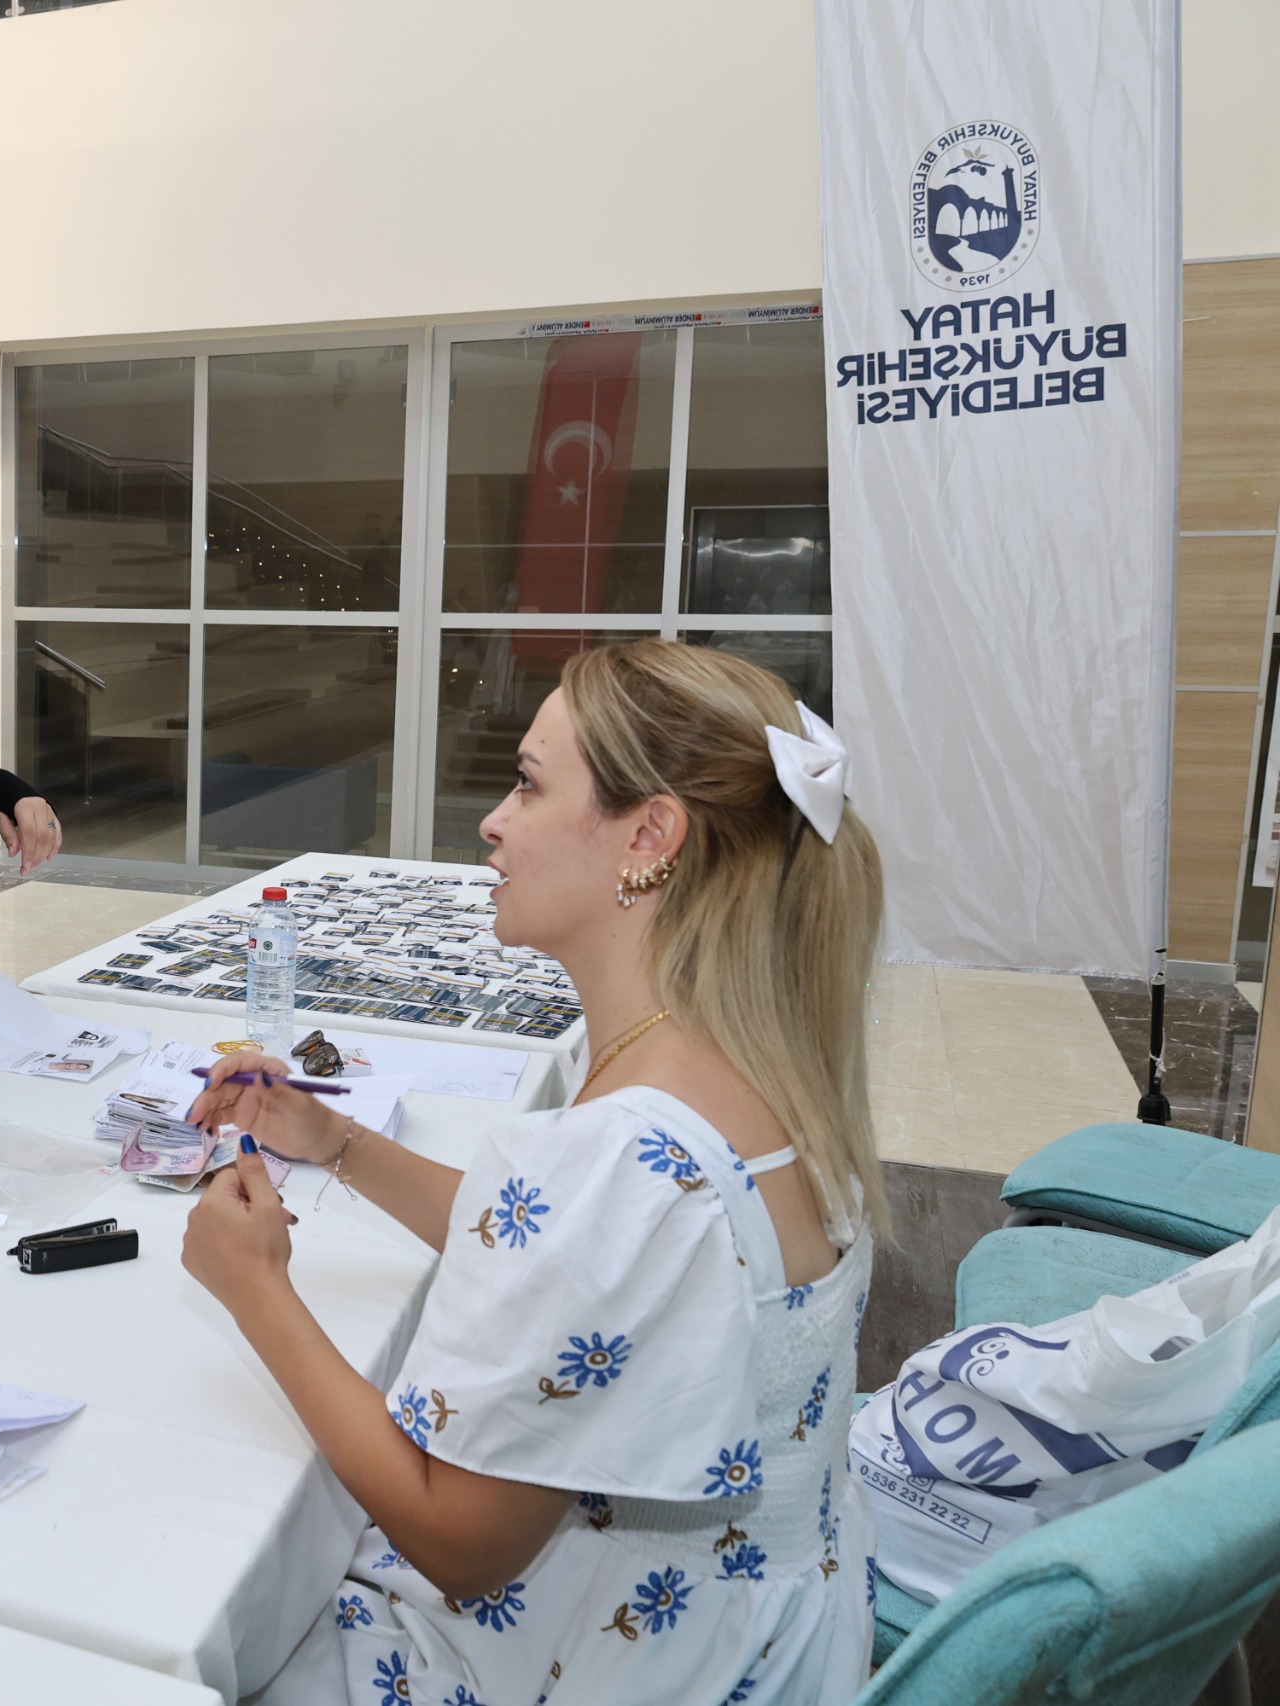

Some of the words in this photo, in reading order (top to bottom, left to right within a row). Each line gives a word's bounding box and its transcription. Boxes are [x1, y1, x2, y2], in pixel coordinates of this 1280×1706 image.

[860, 1464, 898, 1492] 0.536
[899, 1487, 926, 1507] 231
[928, 1501, 949, 1518] 22
[950, 1512, 970, 1530] 22
